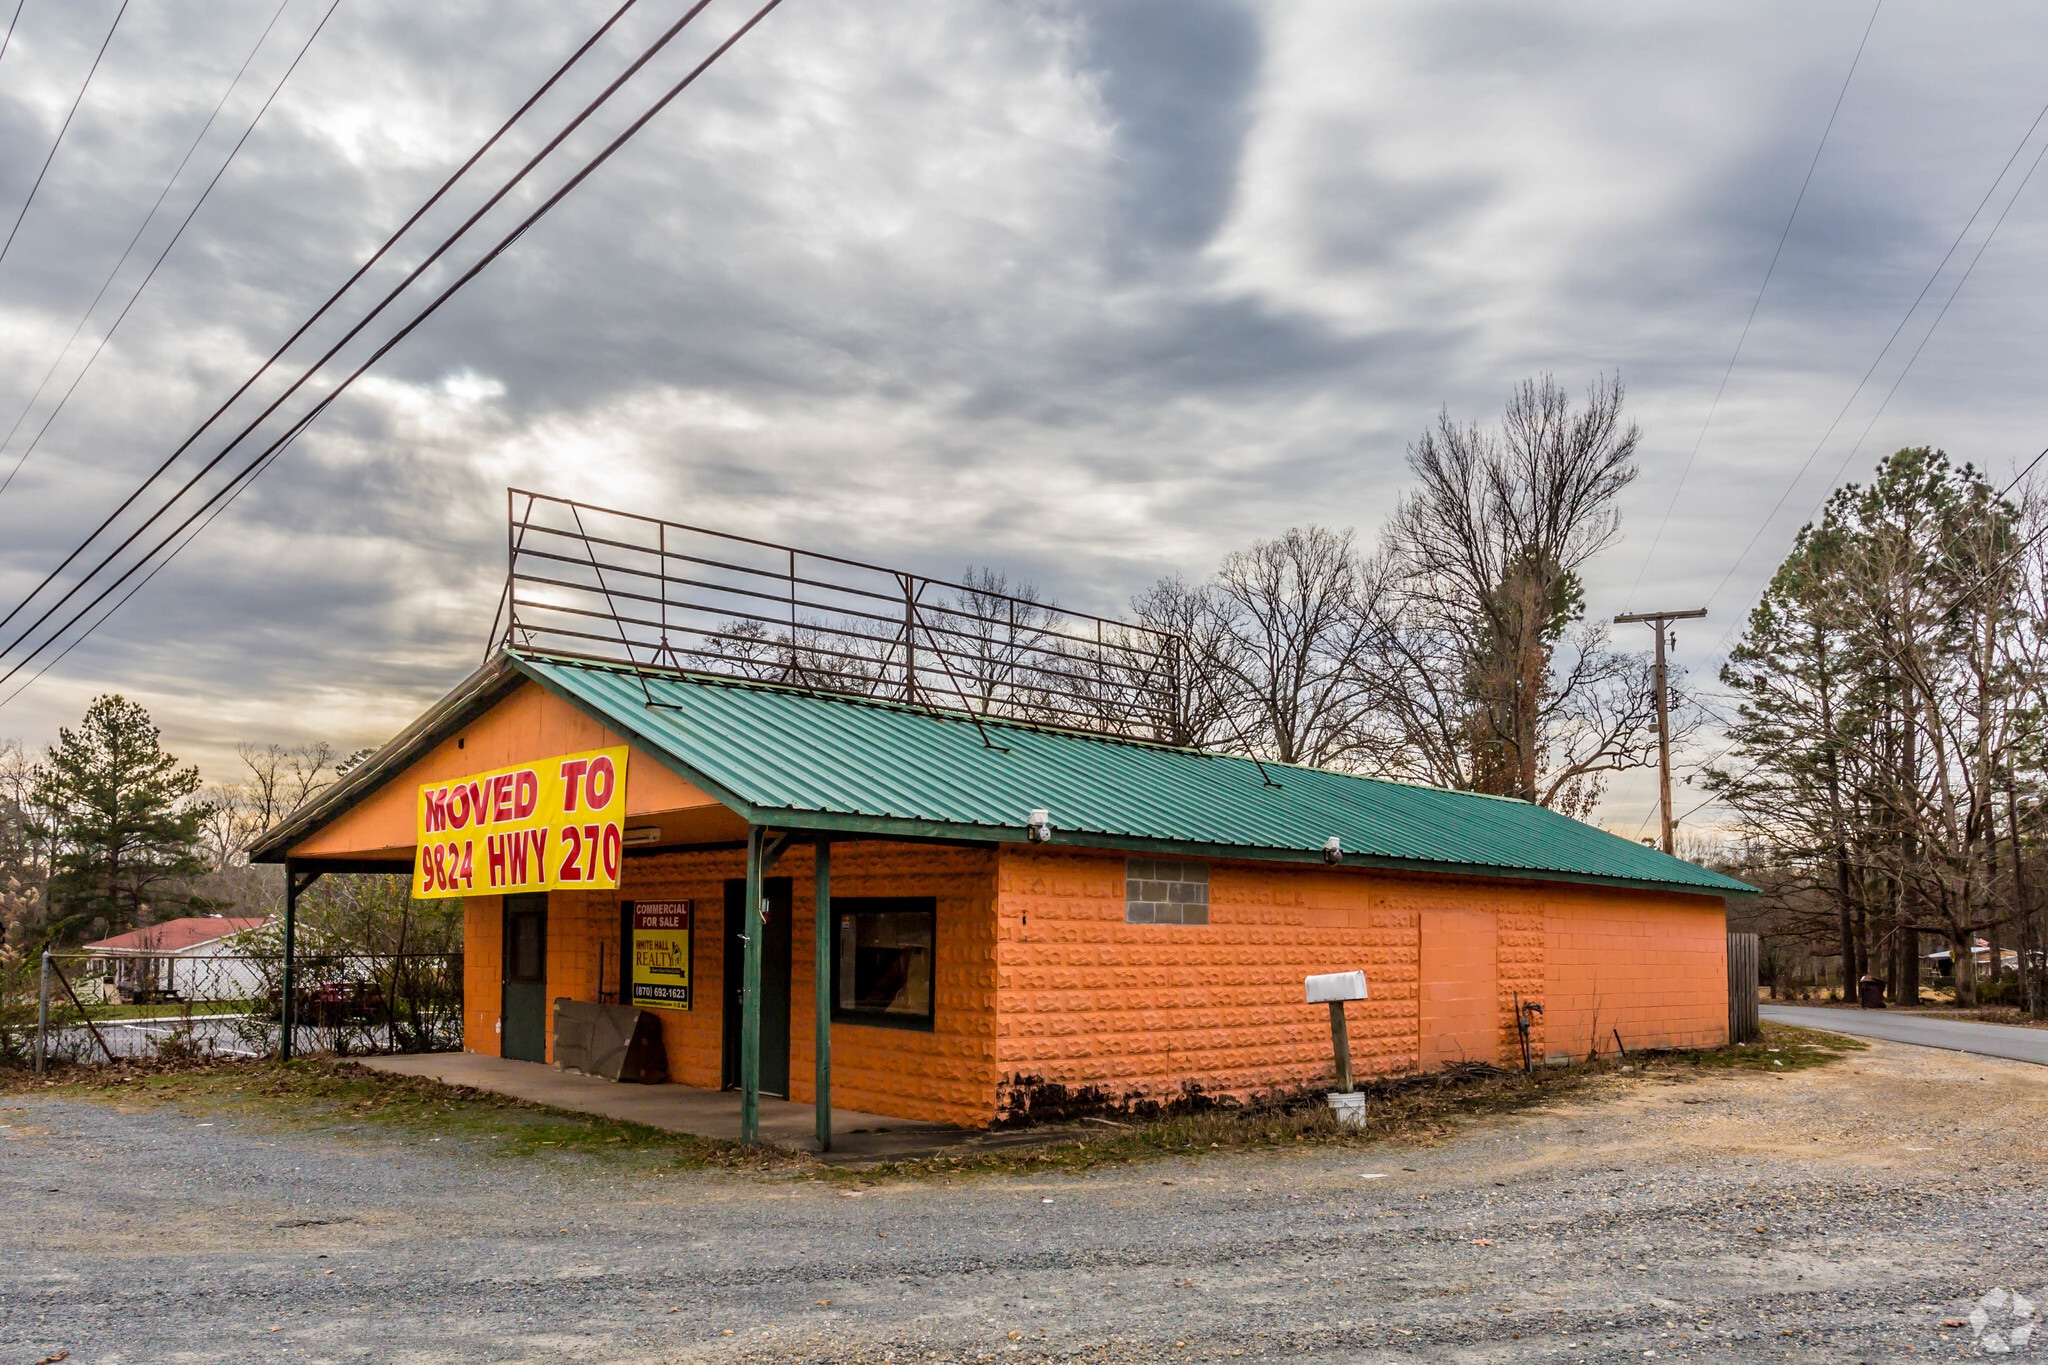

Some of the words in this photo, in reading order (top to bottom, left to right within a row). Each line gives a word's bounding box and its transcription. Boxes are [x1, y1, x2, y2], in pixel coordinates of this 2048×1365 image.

[425, 770, 538, 833] MOVED
[560, 755, 615, 812] TO
[422, 840, 473, 893] 9824
[487, 827, 549, 887] HWY
[559, 822, 621, 881] 270
[636, 904, 687, 915] COMMERCIAL
[642, 916, 658, 927] FOR
[659, 916, 680, 927] SALE
[636, 940, 653, 950] WHITE
[655, 940, 669, 951] HALL
[636, 951, 674, 967] REALTY
[635, 985, 653, 998] (870)
[654, 987, 686, 999] 692-1623
